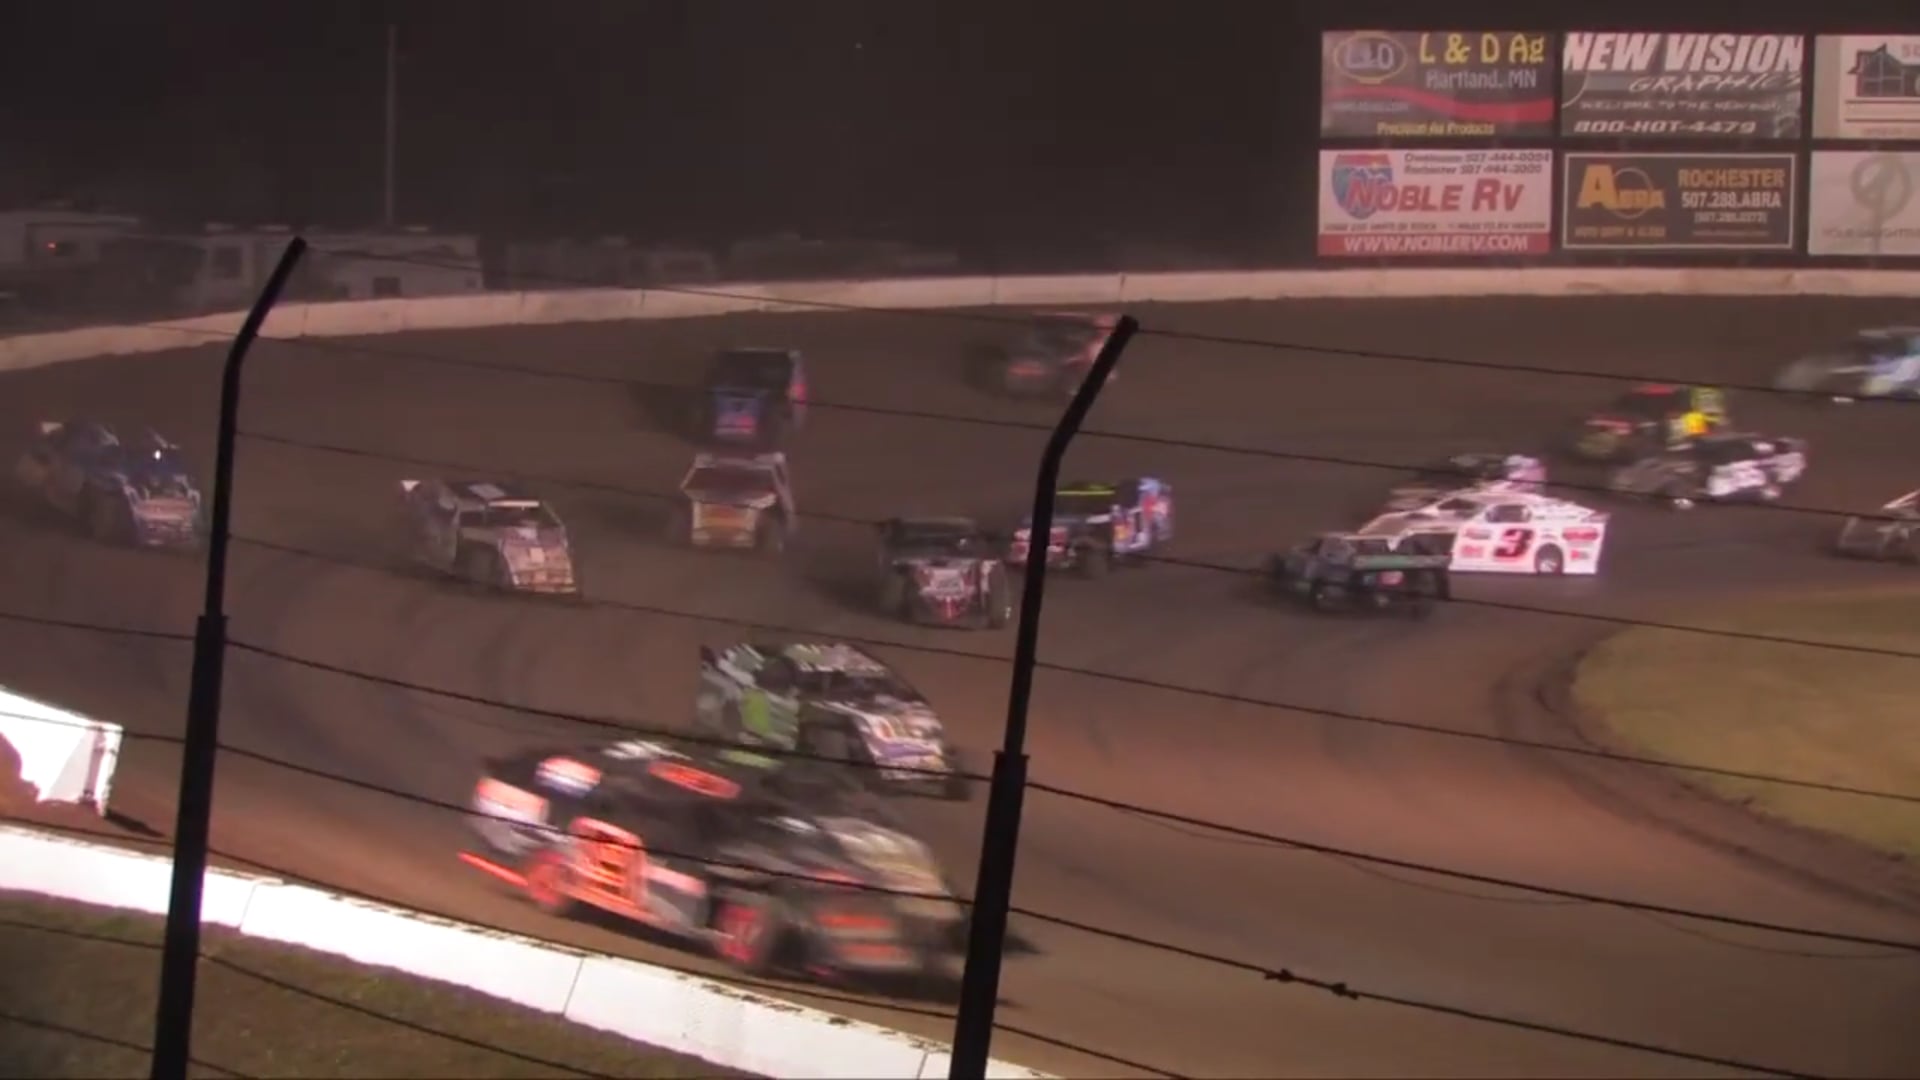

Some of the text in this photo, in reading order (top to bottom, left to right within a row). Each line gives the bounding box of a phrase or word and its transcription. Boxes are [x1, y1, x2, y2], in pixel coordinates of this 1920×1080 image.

[1419, 33, 1545, 63] L & D Ag
[1563, 33, 1804, 73] NEW VISION
[1508, 68, 1537, 88] MN
[1574, 119, 1756, 134] 800-HOT-4479
[1678, 168, 1786, 188] ROCHESTER
[1345, 180, 1463, 213] NOBLE
[1344, 234, 1529, 252] WWW.NOBLERV.COM
[1493, 527, 1535, 559] 3
